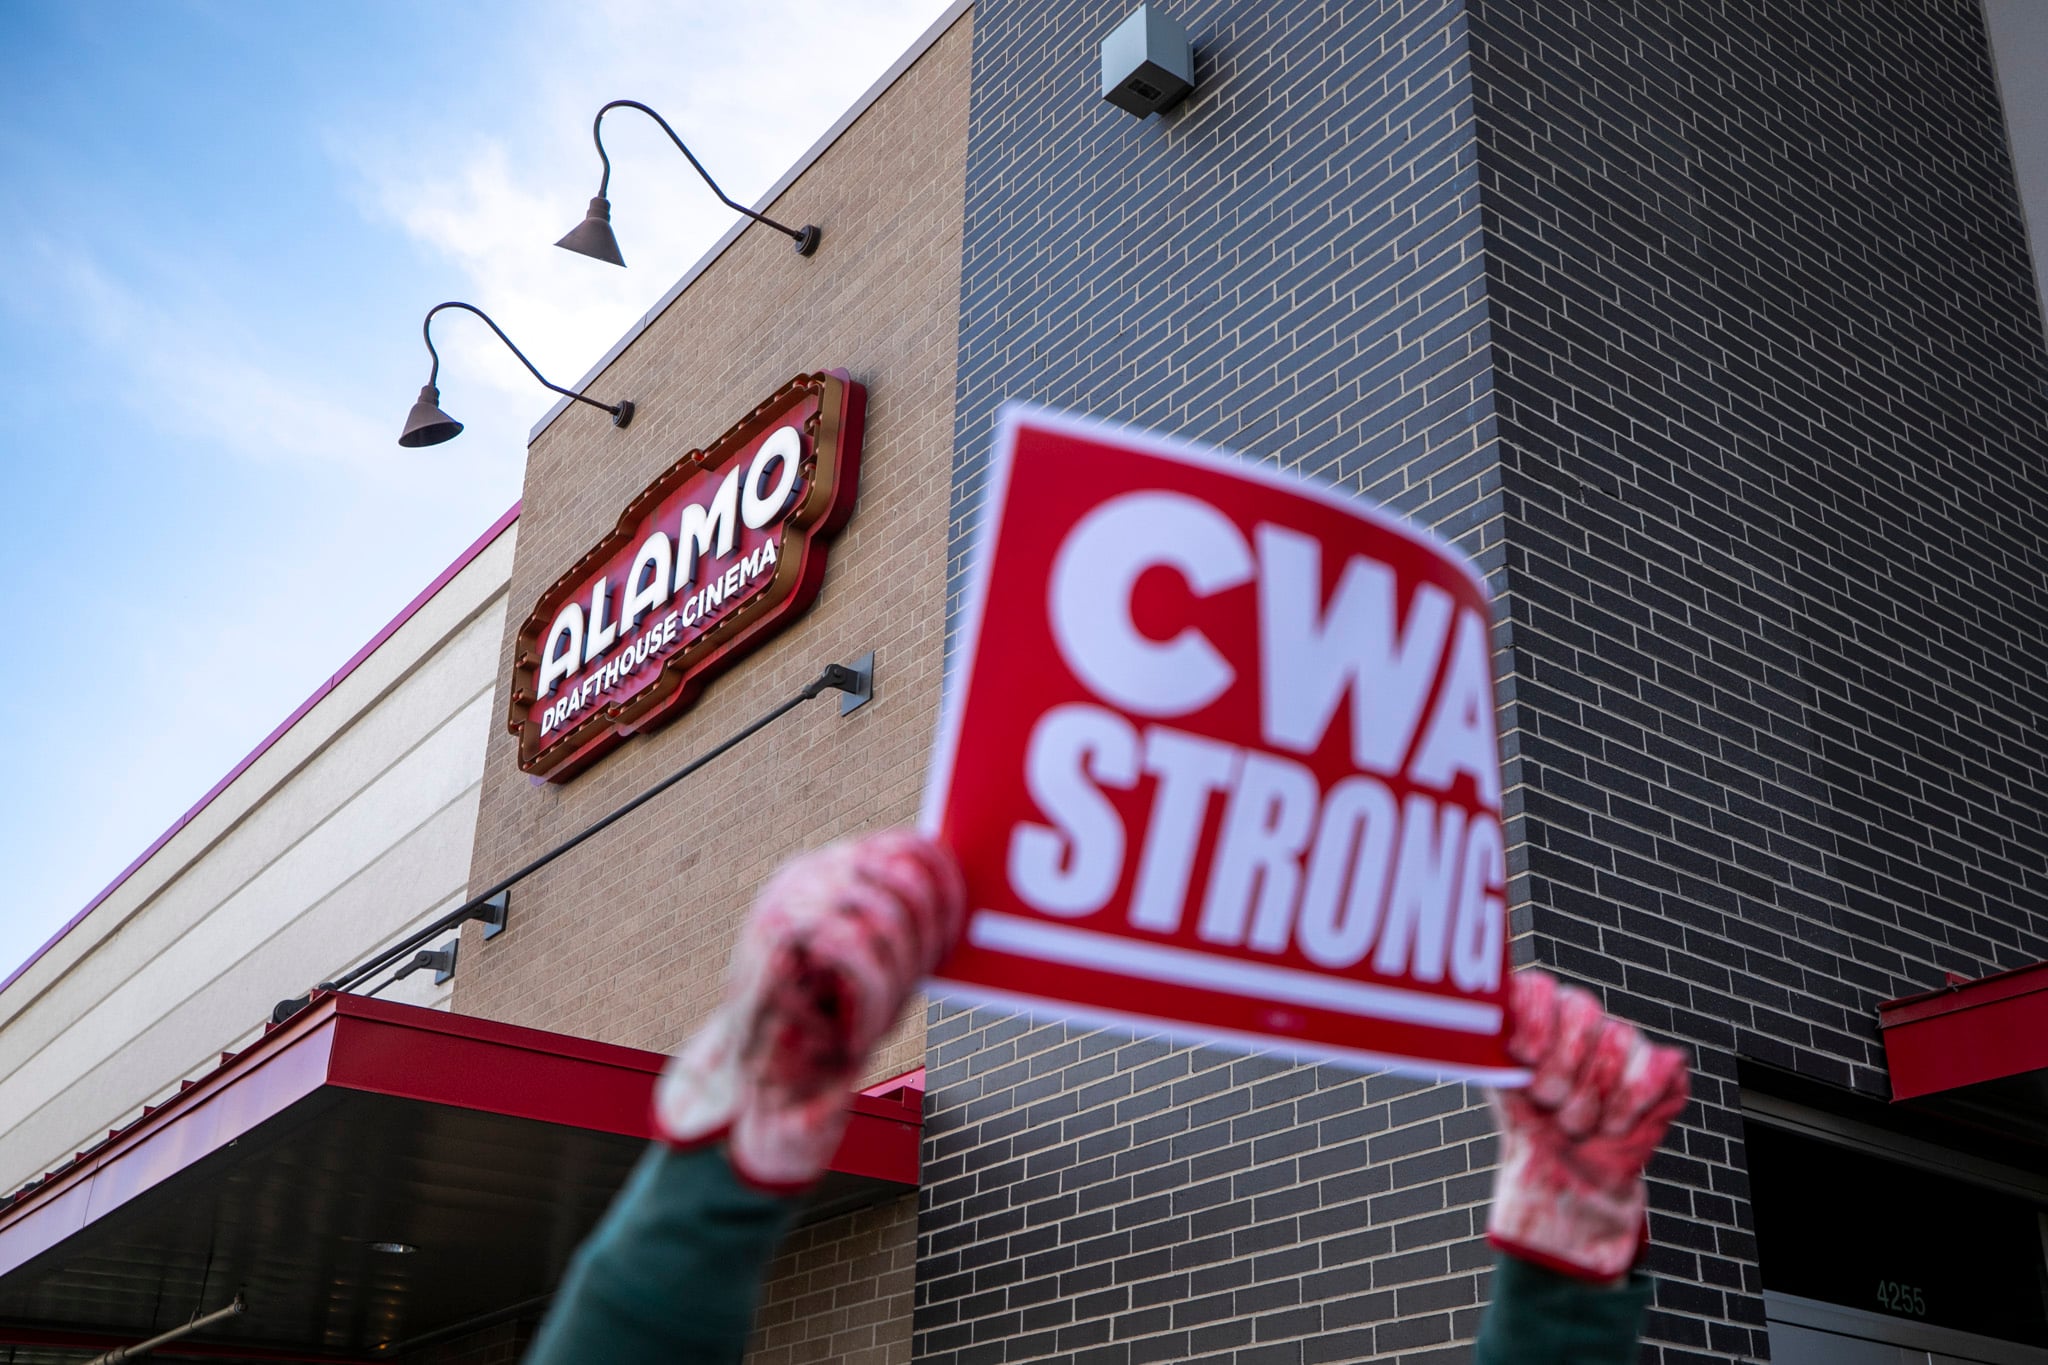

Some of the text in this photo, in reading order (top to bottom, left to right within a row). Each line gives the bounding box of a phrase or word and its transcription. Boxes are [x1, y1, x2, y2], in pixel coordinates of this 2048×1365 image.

[537, 426, 800, 700] ALAMO
[540, 538, 777, 737] DRAFTHOUSE CINEMA
[1049, 490, 1500, 808] CWA
[1008, 703, 1503, 993] STRONG
[1878, 1280, 1926, 1315] 4255
